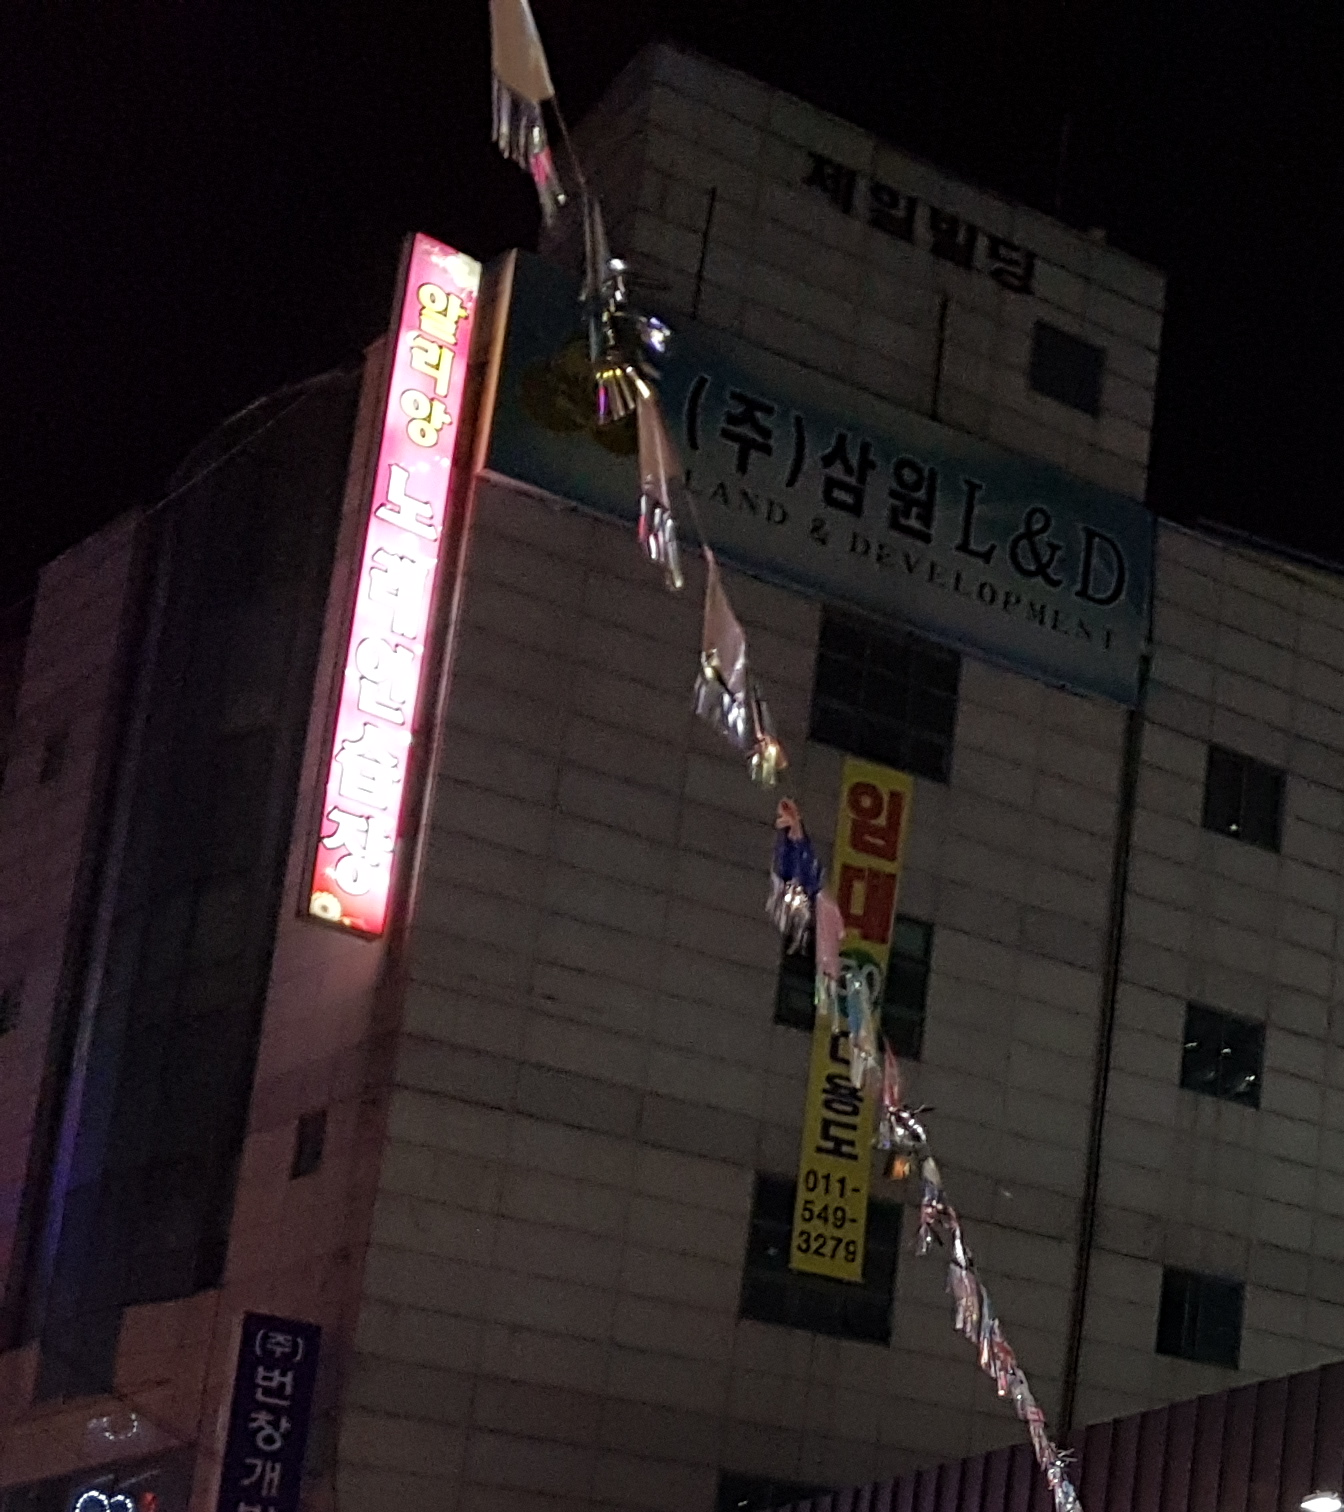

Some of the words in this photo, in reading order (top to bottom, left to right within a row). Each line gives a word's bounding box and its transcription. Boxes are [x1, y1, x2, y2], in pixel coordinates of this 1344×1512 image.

[848, 531, 1116, 651] DEVELOPMENT
[836, 780, 906, 945] 임대
[801, 1200, 857, 1229] 549-
[804, 1168, 861, 1198] 011-
